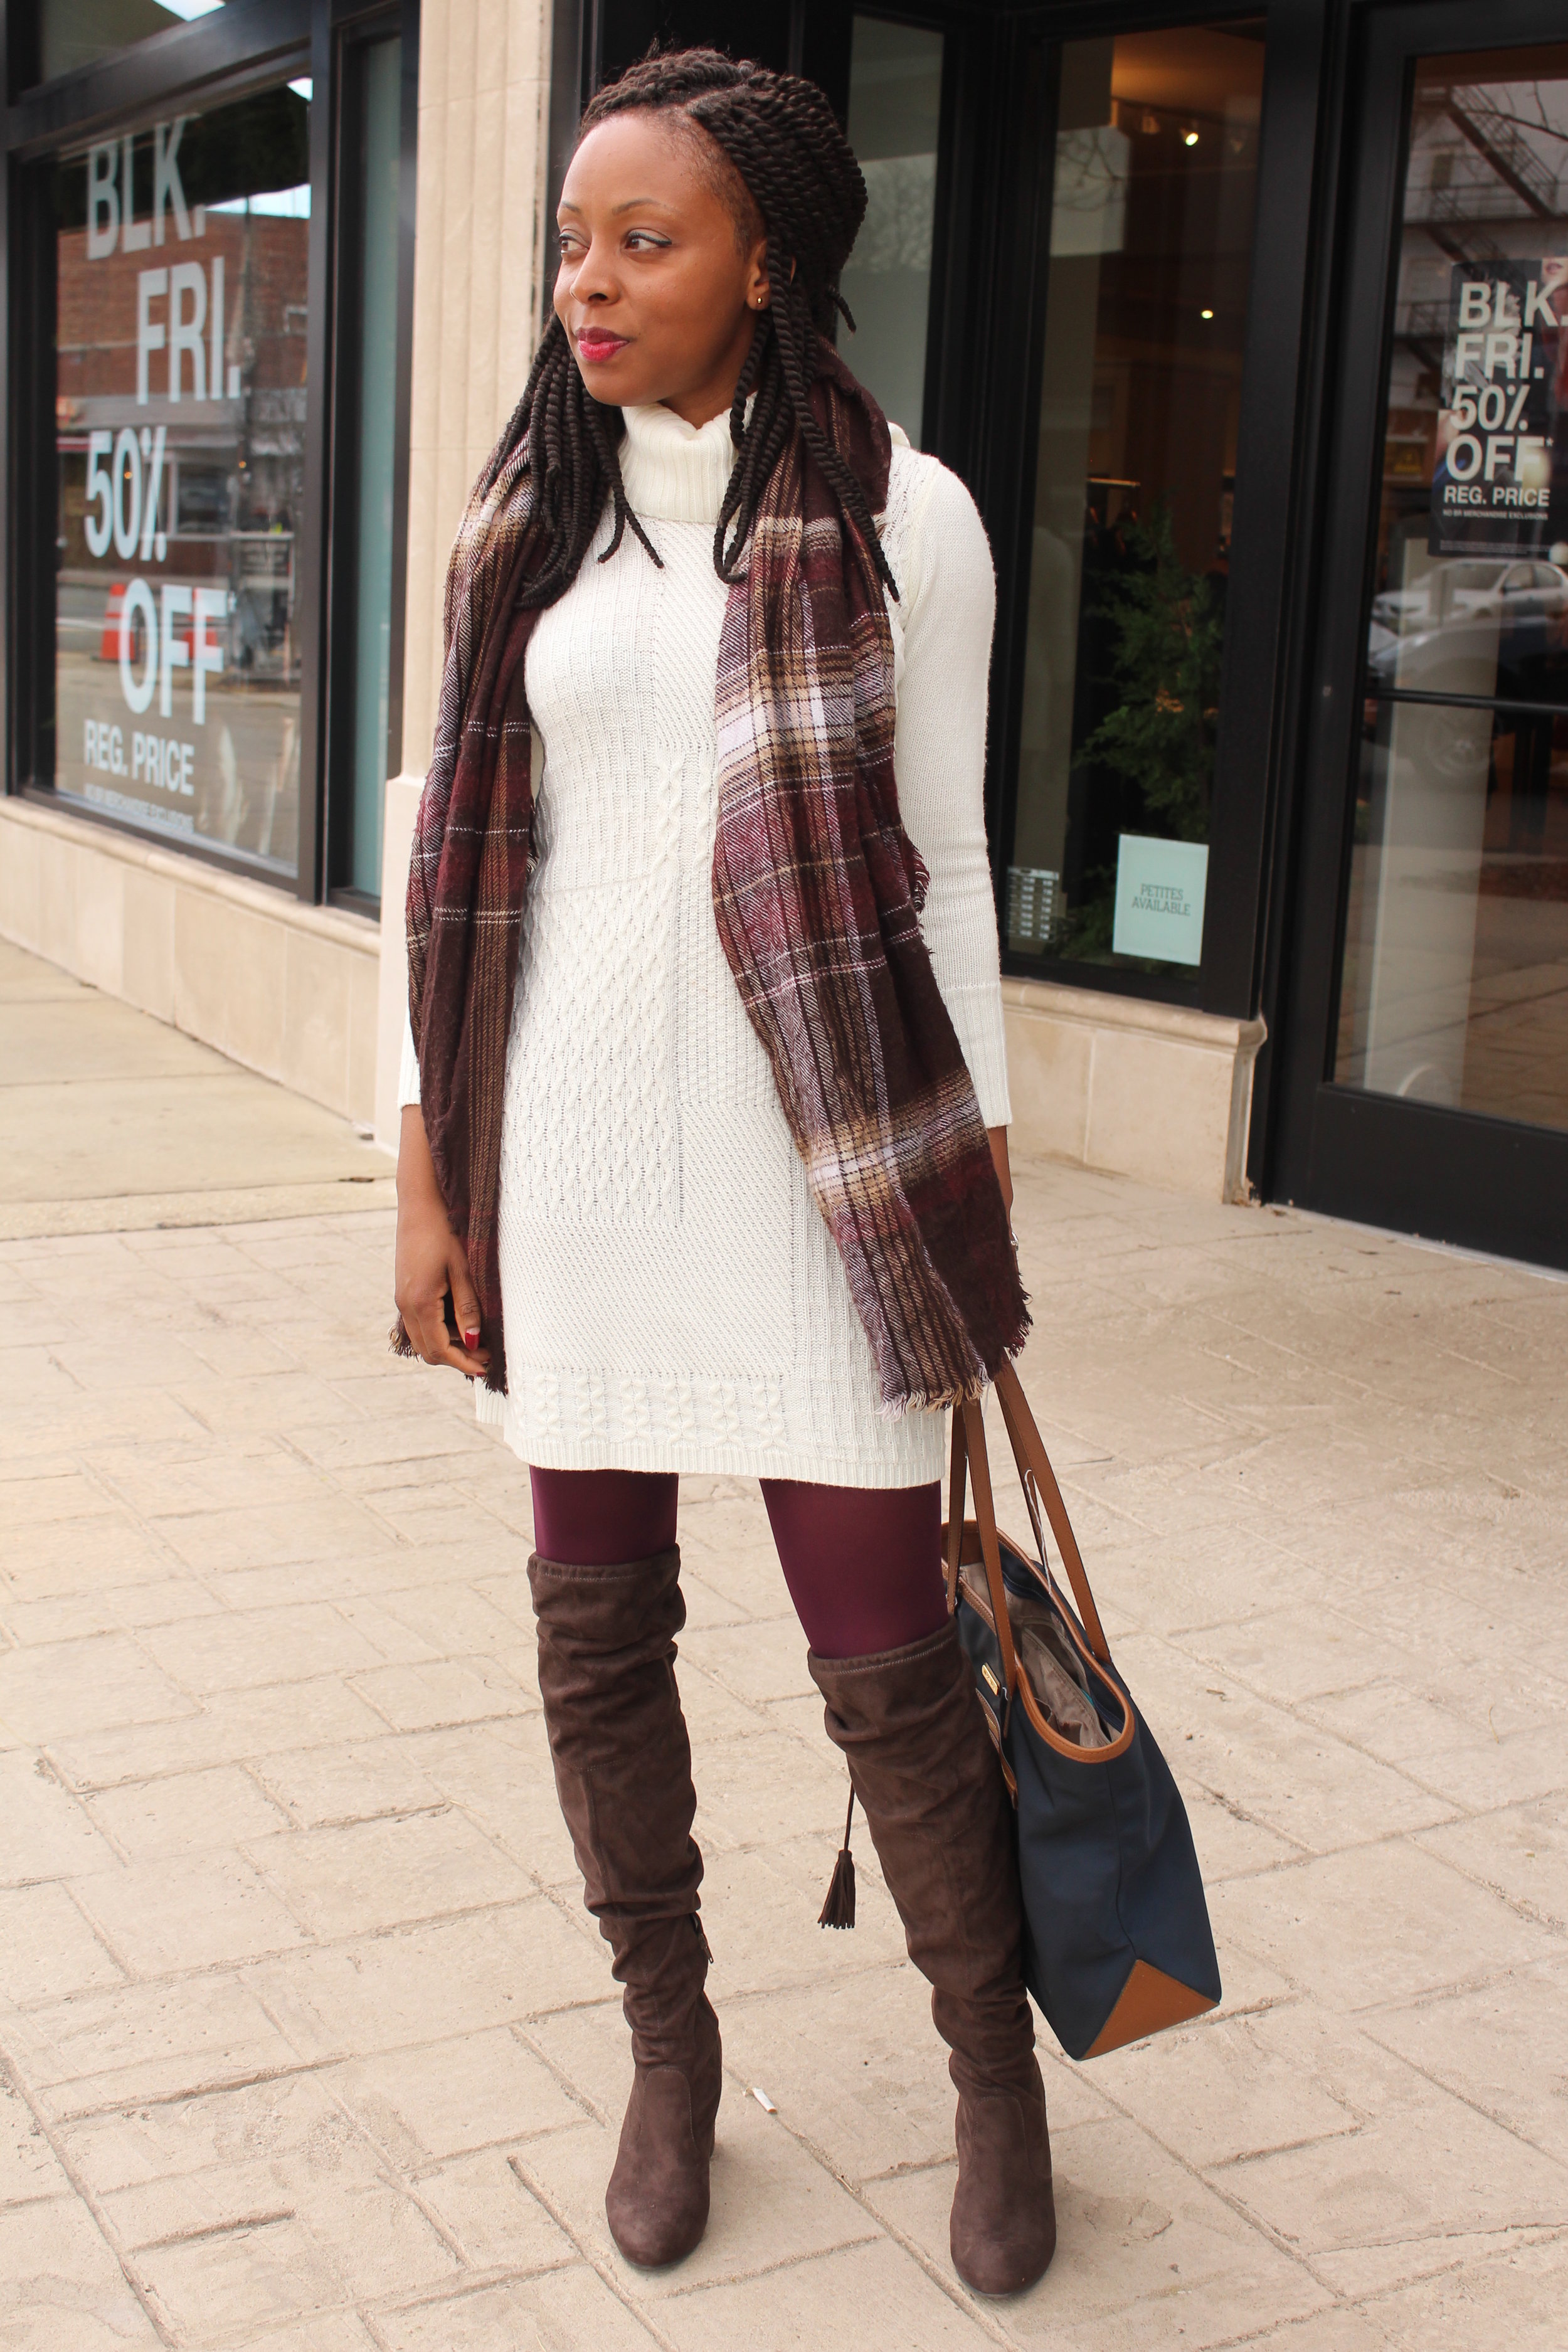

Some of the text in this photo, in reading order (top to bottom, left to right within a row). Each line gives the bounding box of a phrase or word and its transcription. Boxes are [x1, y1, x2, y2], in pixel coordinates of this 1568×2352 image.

[87, 113, 206, 261] BLK.
[1458, 280, 1568, 328] BLK.
[136, 256, 241, 406] FRI.
[1454, 332, 1544, 379] FRI.
[1449, 384, 1530, 431] 50%
[84, 425, 167, 563] 50%
[1444, 485, 1550, 507] REG. PRICE
[84, 719, 194, 797] REG. PRICE
[1131, 896, 1191, 917] AVAILABLE
[1140, 883, 1184, 901] PETITES
